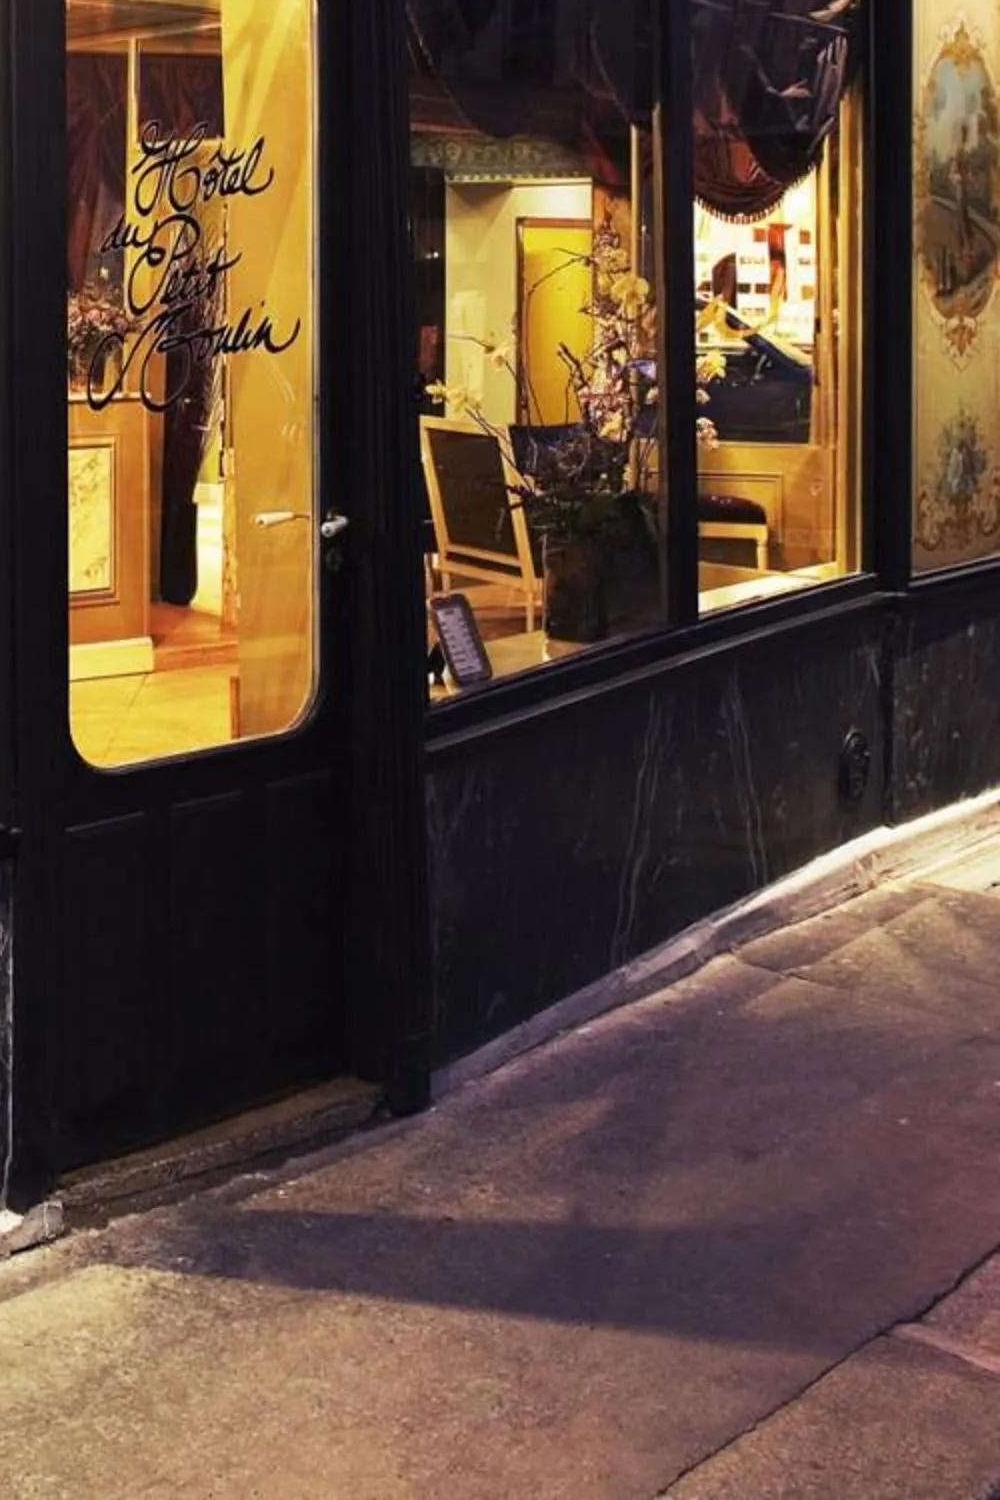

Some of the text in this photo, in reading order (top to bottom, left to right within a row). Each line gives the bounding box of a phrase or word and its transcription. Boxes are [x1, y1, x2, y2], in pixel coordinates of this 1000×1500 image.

[132, 120, 274, 216] Hôtel
[102, 214, 242, 316] du Petit
[88, 301, 301, 411] Moulin
